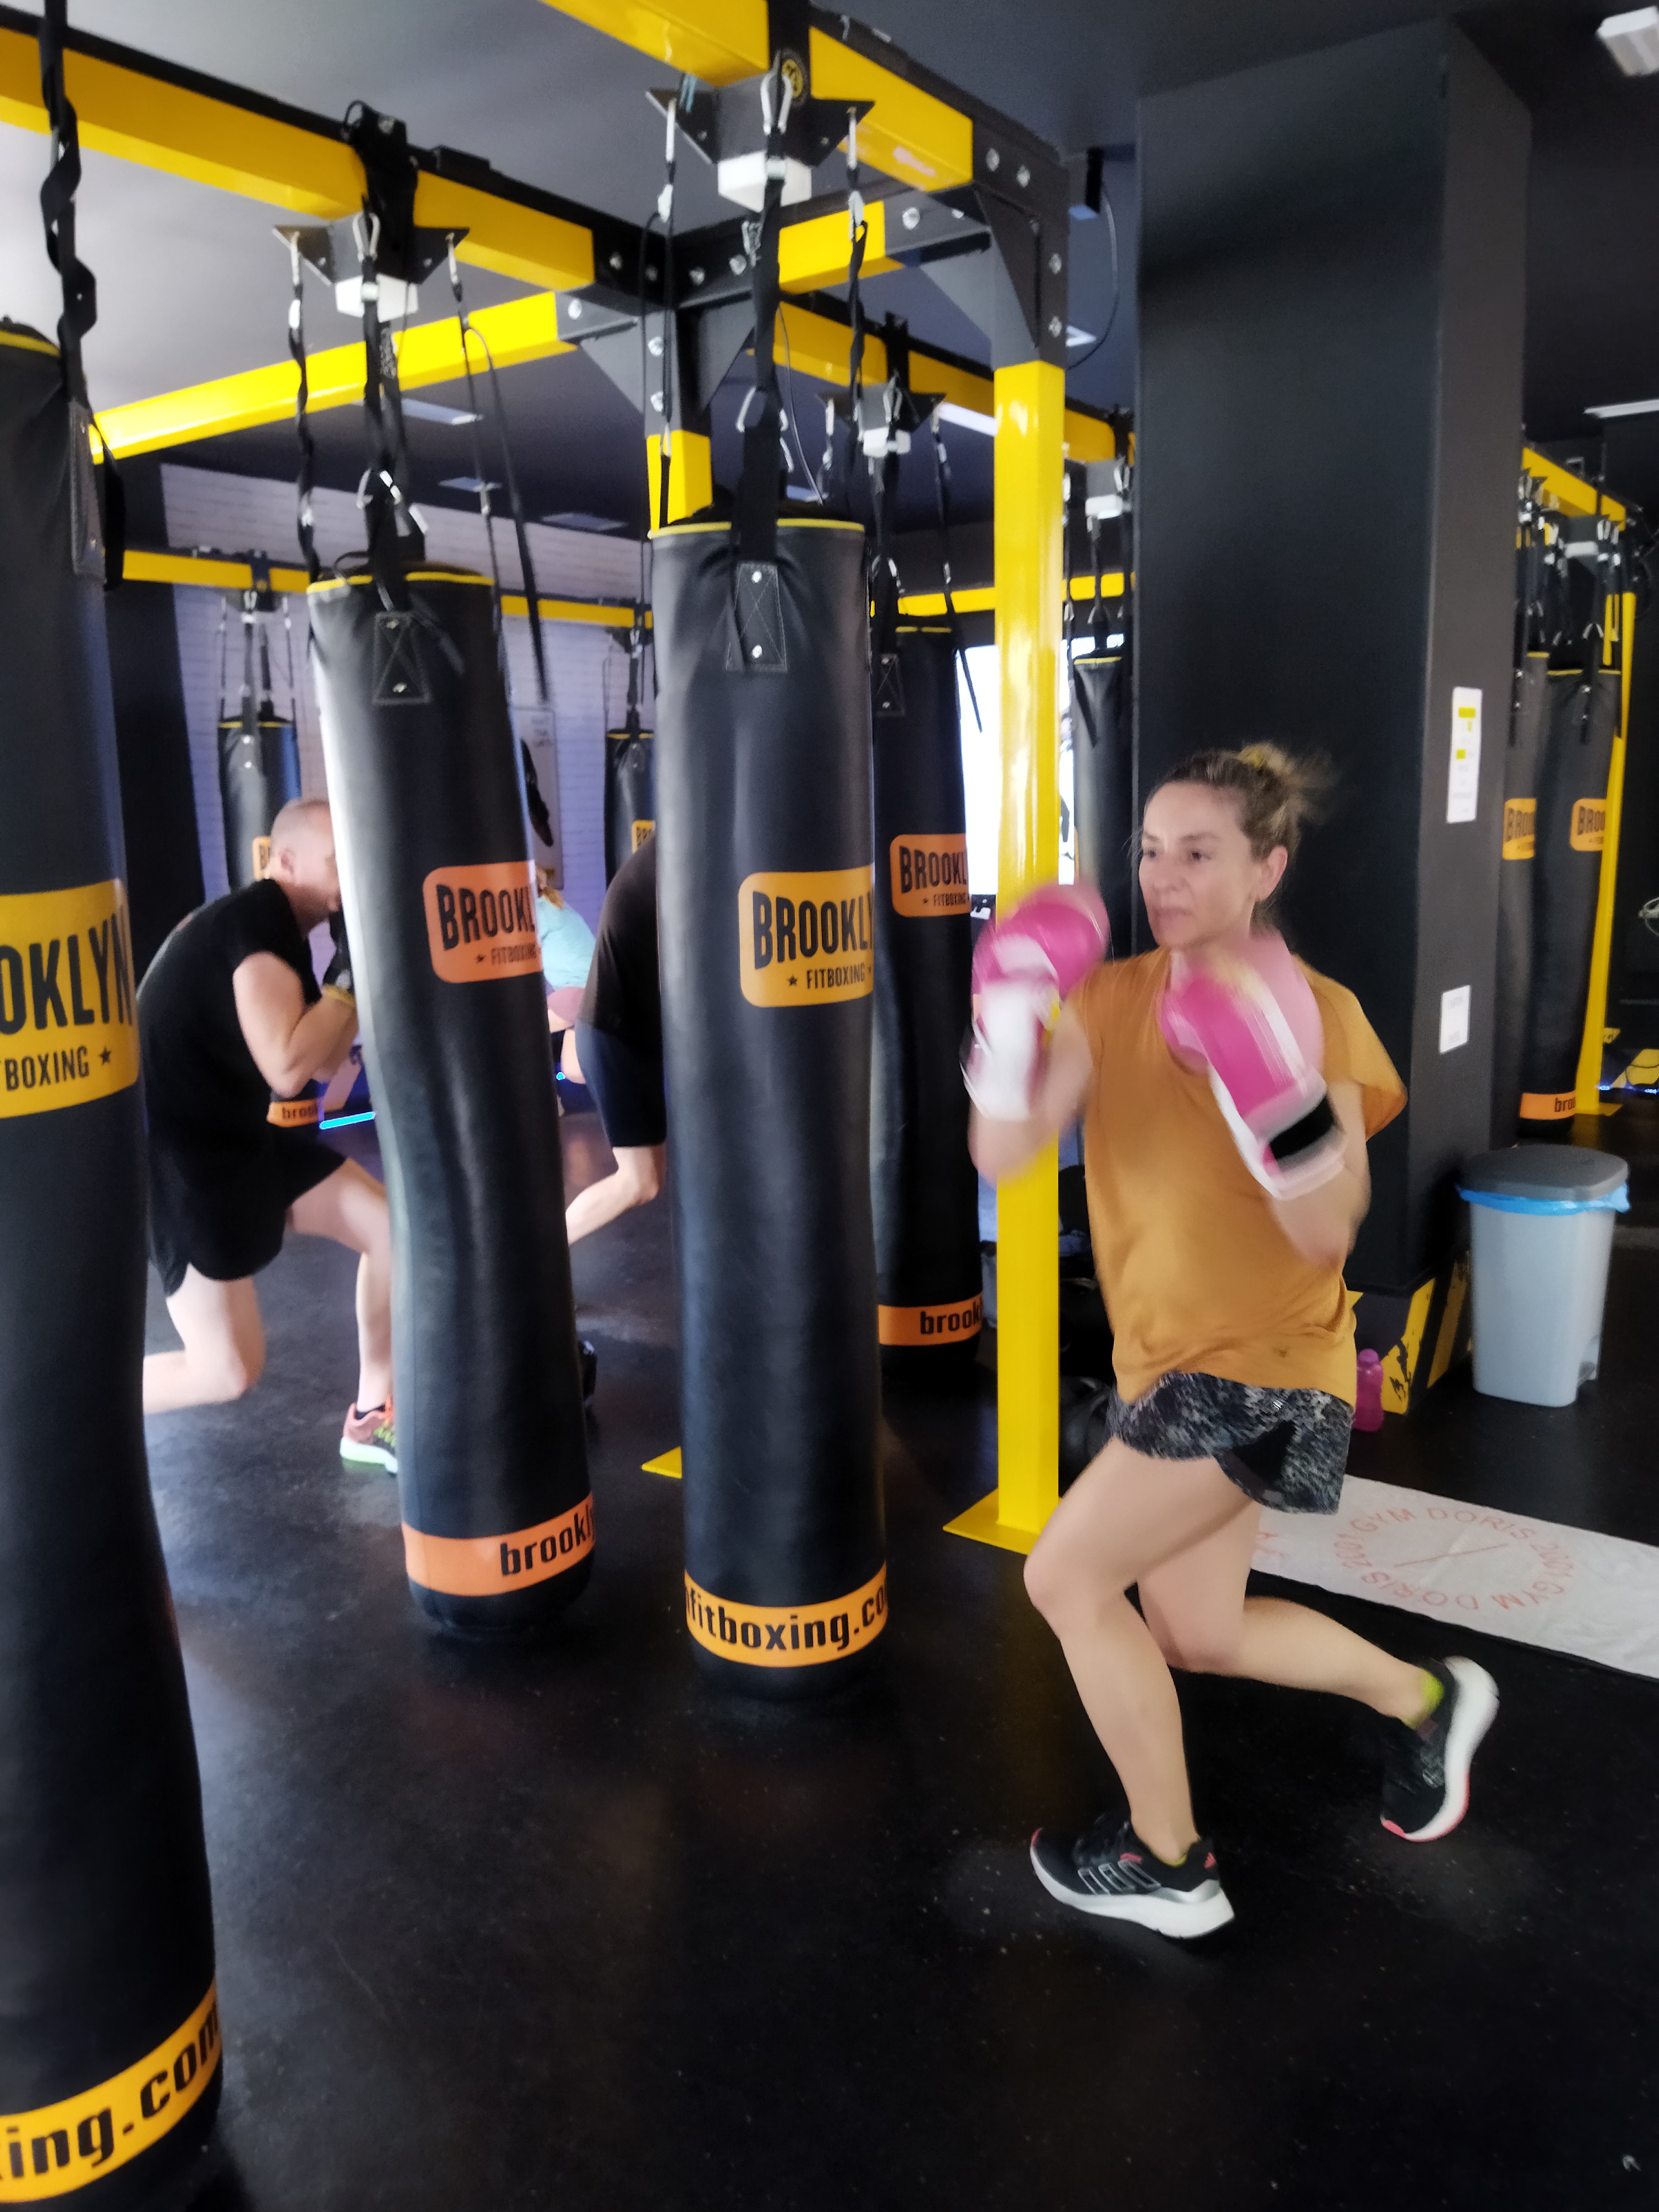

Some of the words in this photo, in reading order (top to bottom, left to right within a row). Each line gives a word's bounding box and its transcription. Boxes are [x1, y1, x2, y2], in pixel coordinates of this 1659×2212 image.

[806, 962, 865, 989] FITBOXING
[0, 1045, 90, 1091] BOXING
[1349, 1507, 1417, 1533] GYM
[1427, 1507, 1536, 1540] DORIS
[0, 2000, 219, 2179] ing.com
